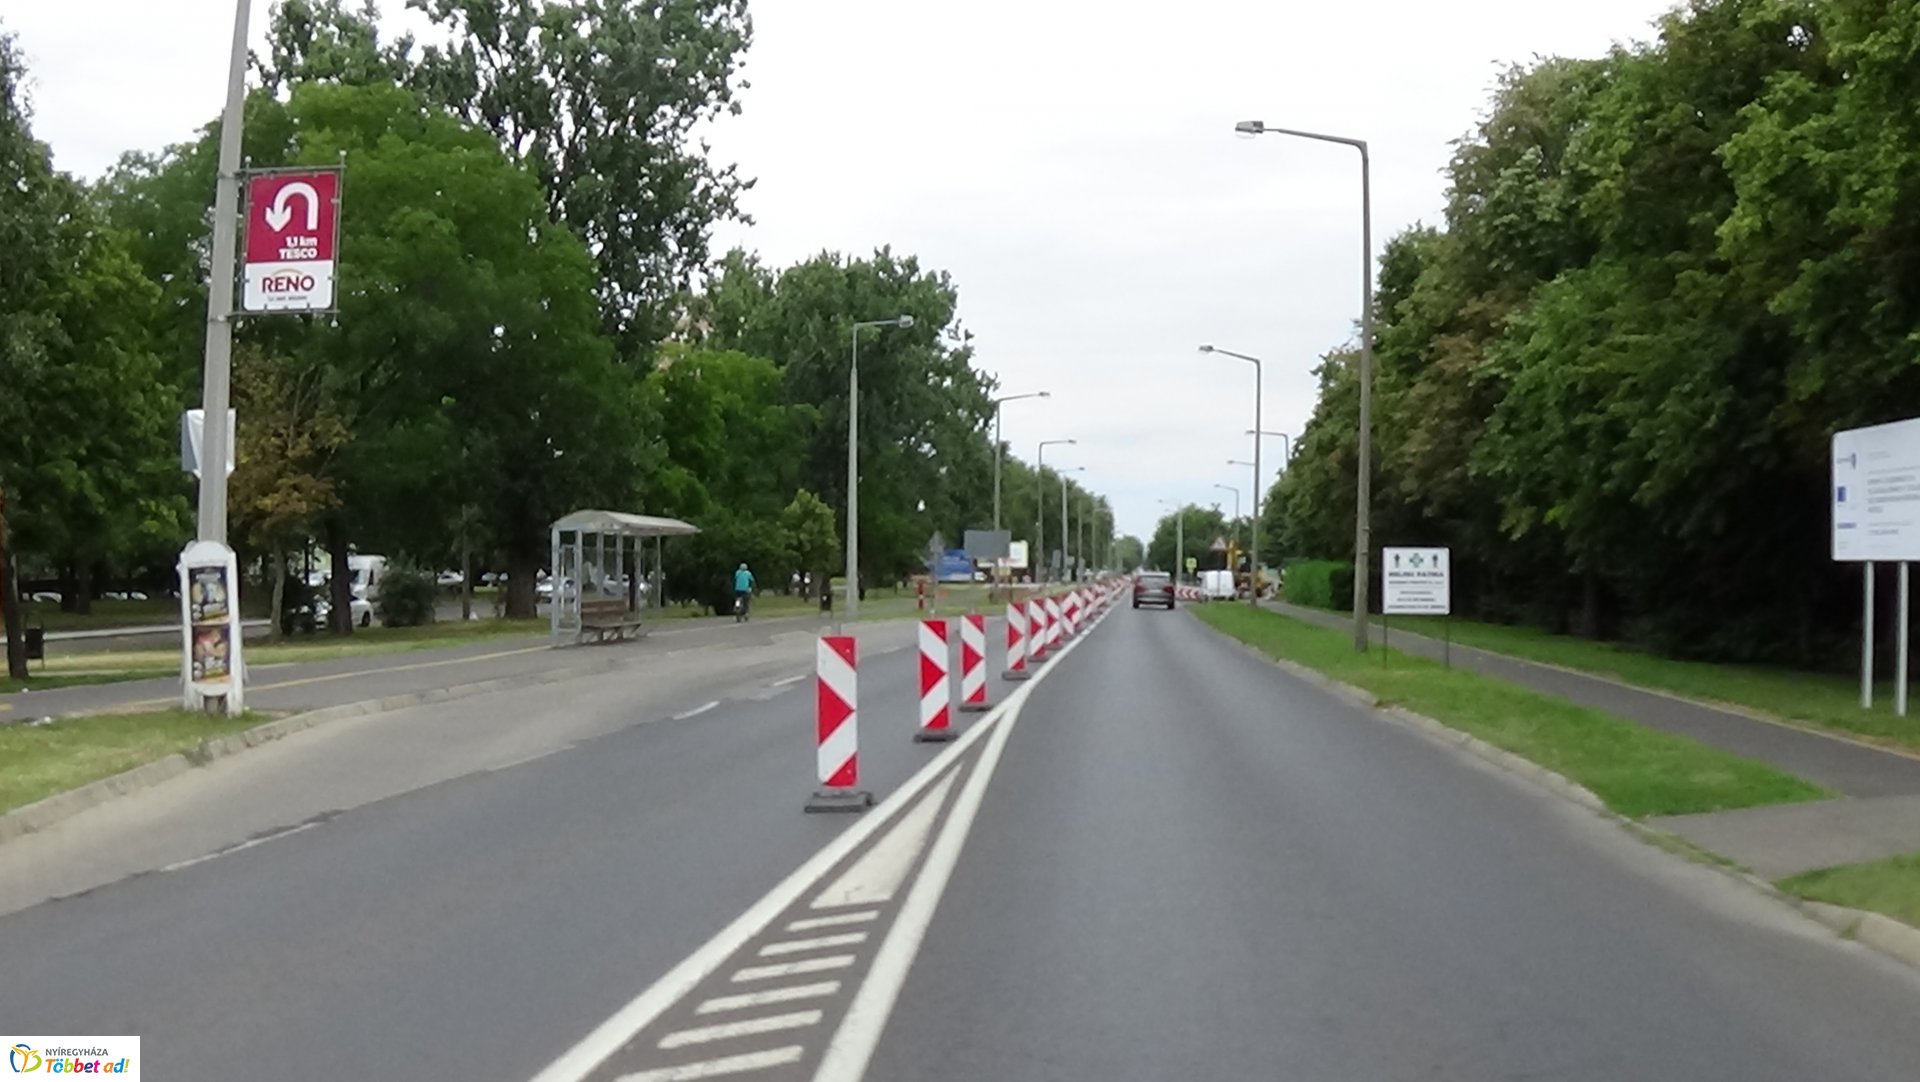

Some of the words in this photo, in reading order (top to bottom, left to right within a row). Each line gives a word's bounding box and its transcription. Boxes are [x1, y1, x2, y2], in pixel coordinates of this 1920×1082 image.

[300, 236, 318, 247] km
[279, 248, 318, 260] TESCO
[262, 275, 315, 293] RENO
